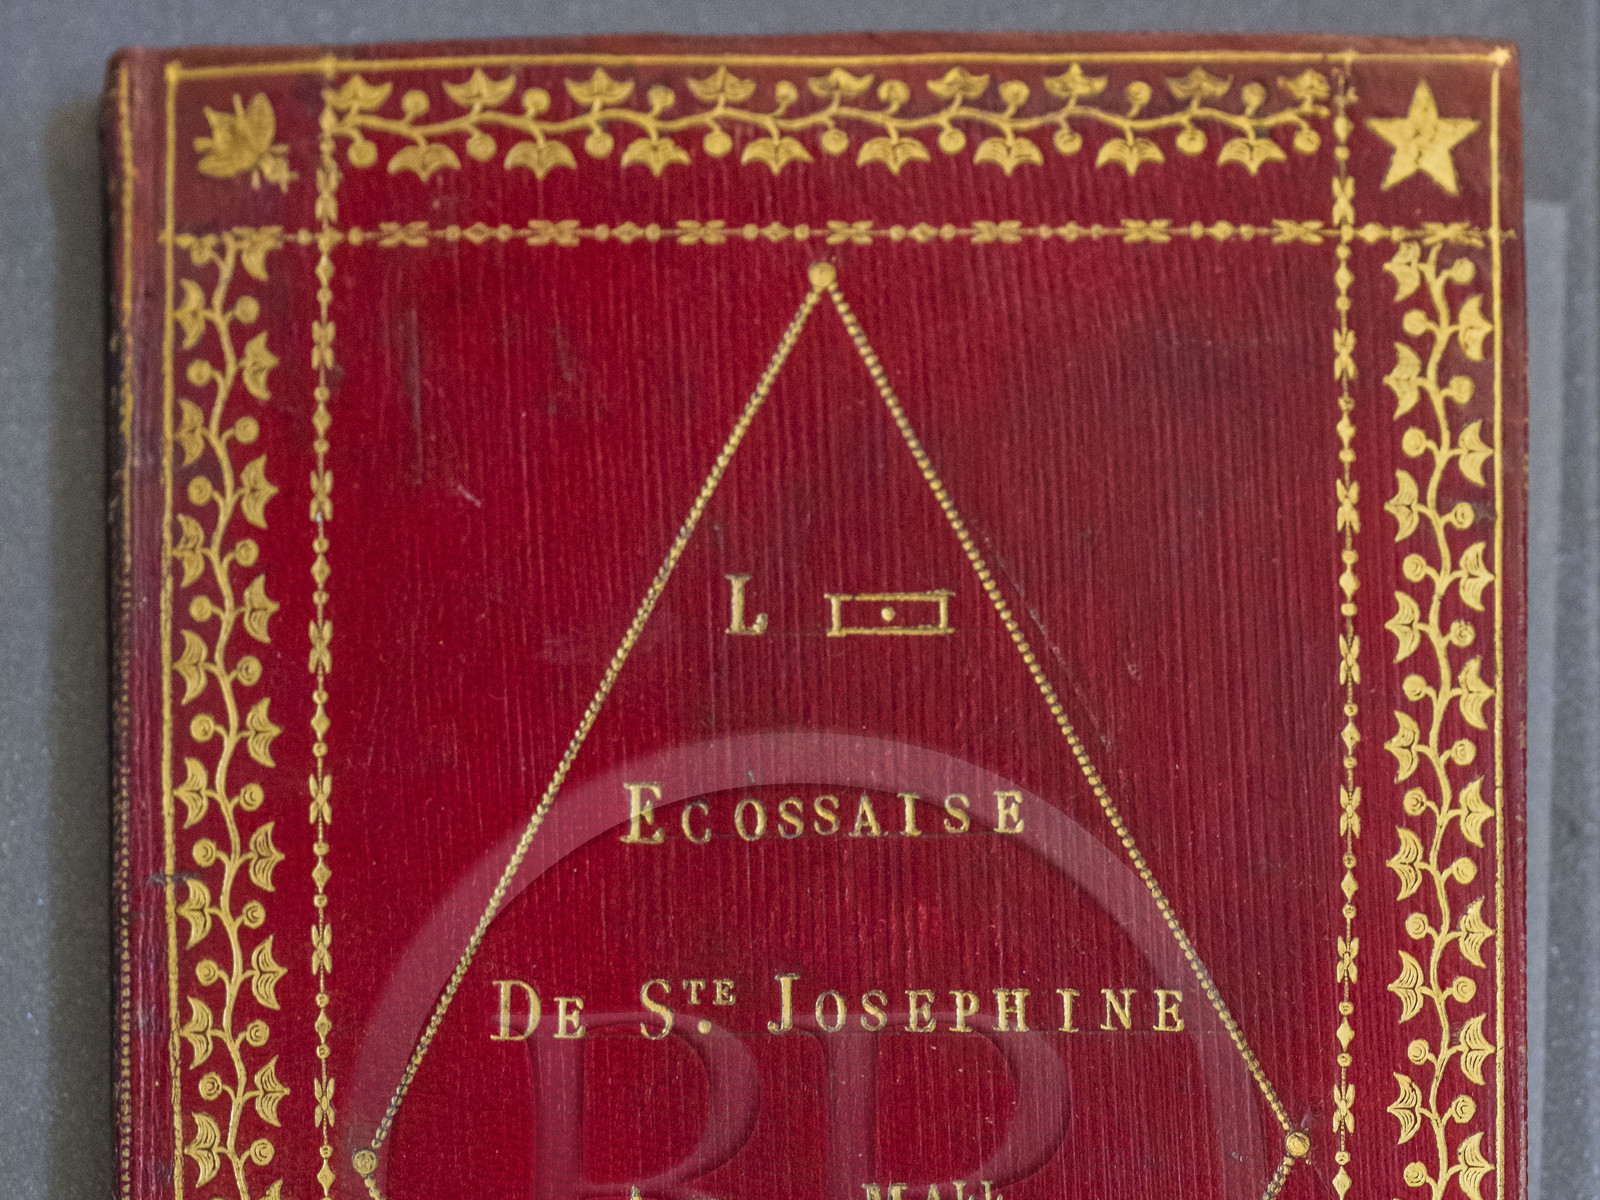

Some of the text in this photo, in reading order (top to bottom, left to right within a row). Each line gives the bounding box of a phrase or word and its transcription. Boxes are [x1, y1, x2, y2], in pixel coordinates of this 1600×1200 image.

[620, 780, 1026, 845] ECOSSAISE
[490, 978, 588, 1042] DE
[767, 972, 1187, 1036] JOSEPHINE
